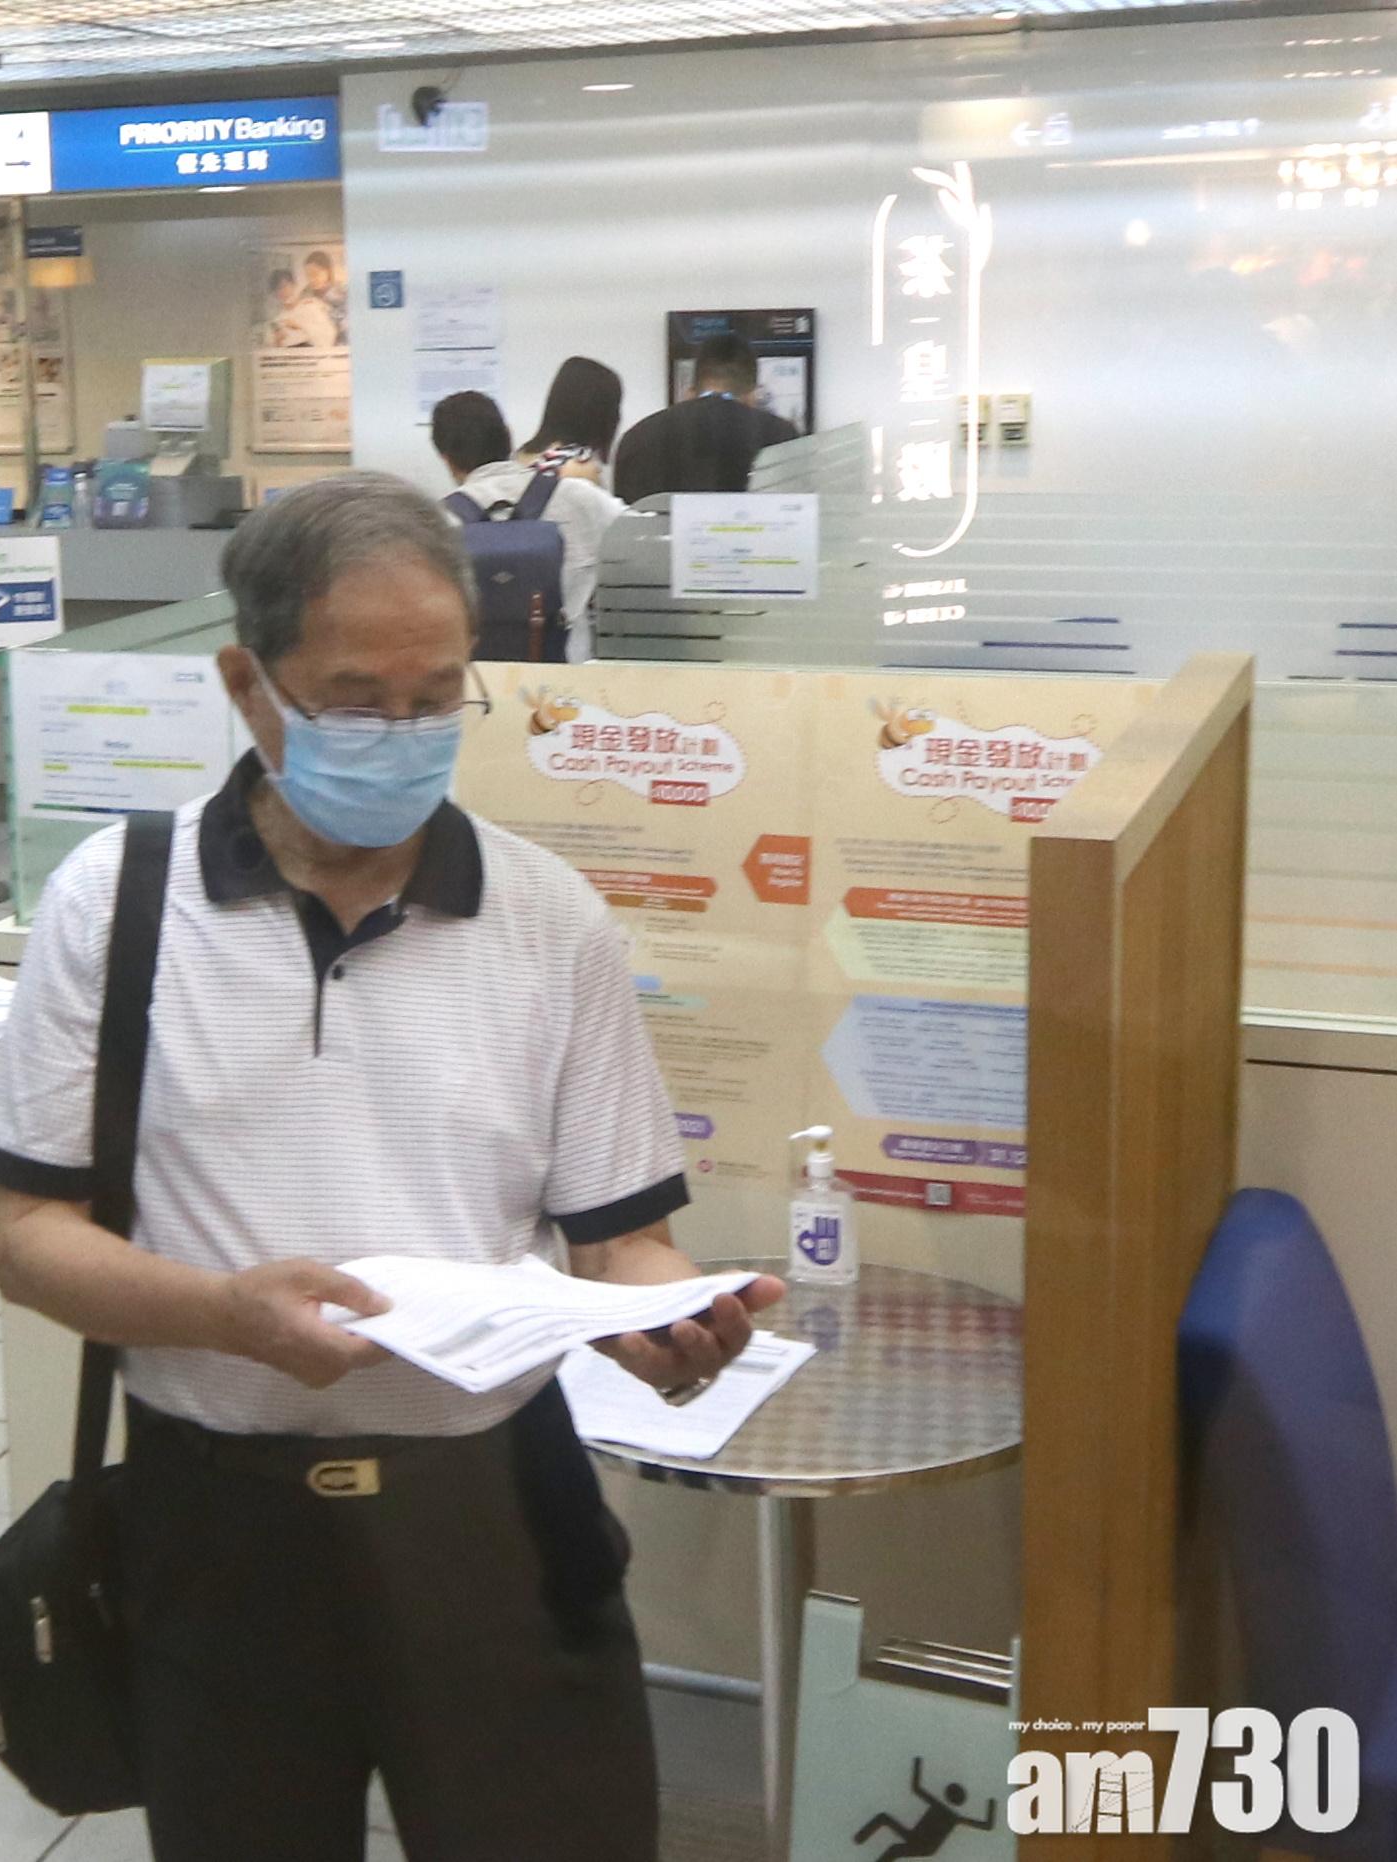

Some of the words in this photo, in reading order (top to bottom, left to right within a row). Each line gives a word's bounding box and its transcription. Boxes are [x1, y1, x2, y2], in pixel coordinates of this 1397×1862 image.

[119, 117, 235, 146] PRIORITY
[234, 115, 327, 141] Banking
[549, 752, 600, 772] Cash
[604, 754, 673, 778] Payout
[898, 768, 954, 788] Cash
[960, 770, 1036, 794] Payout
